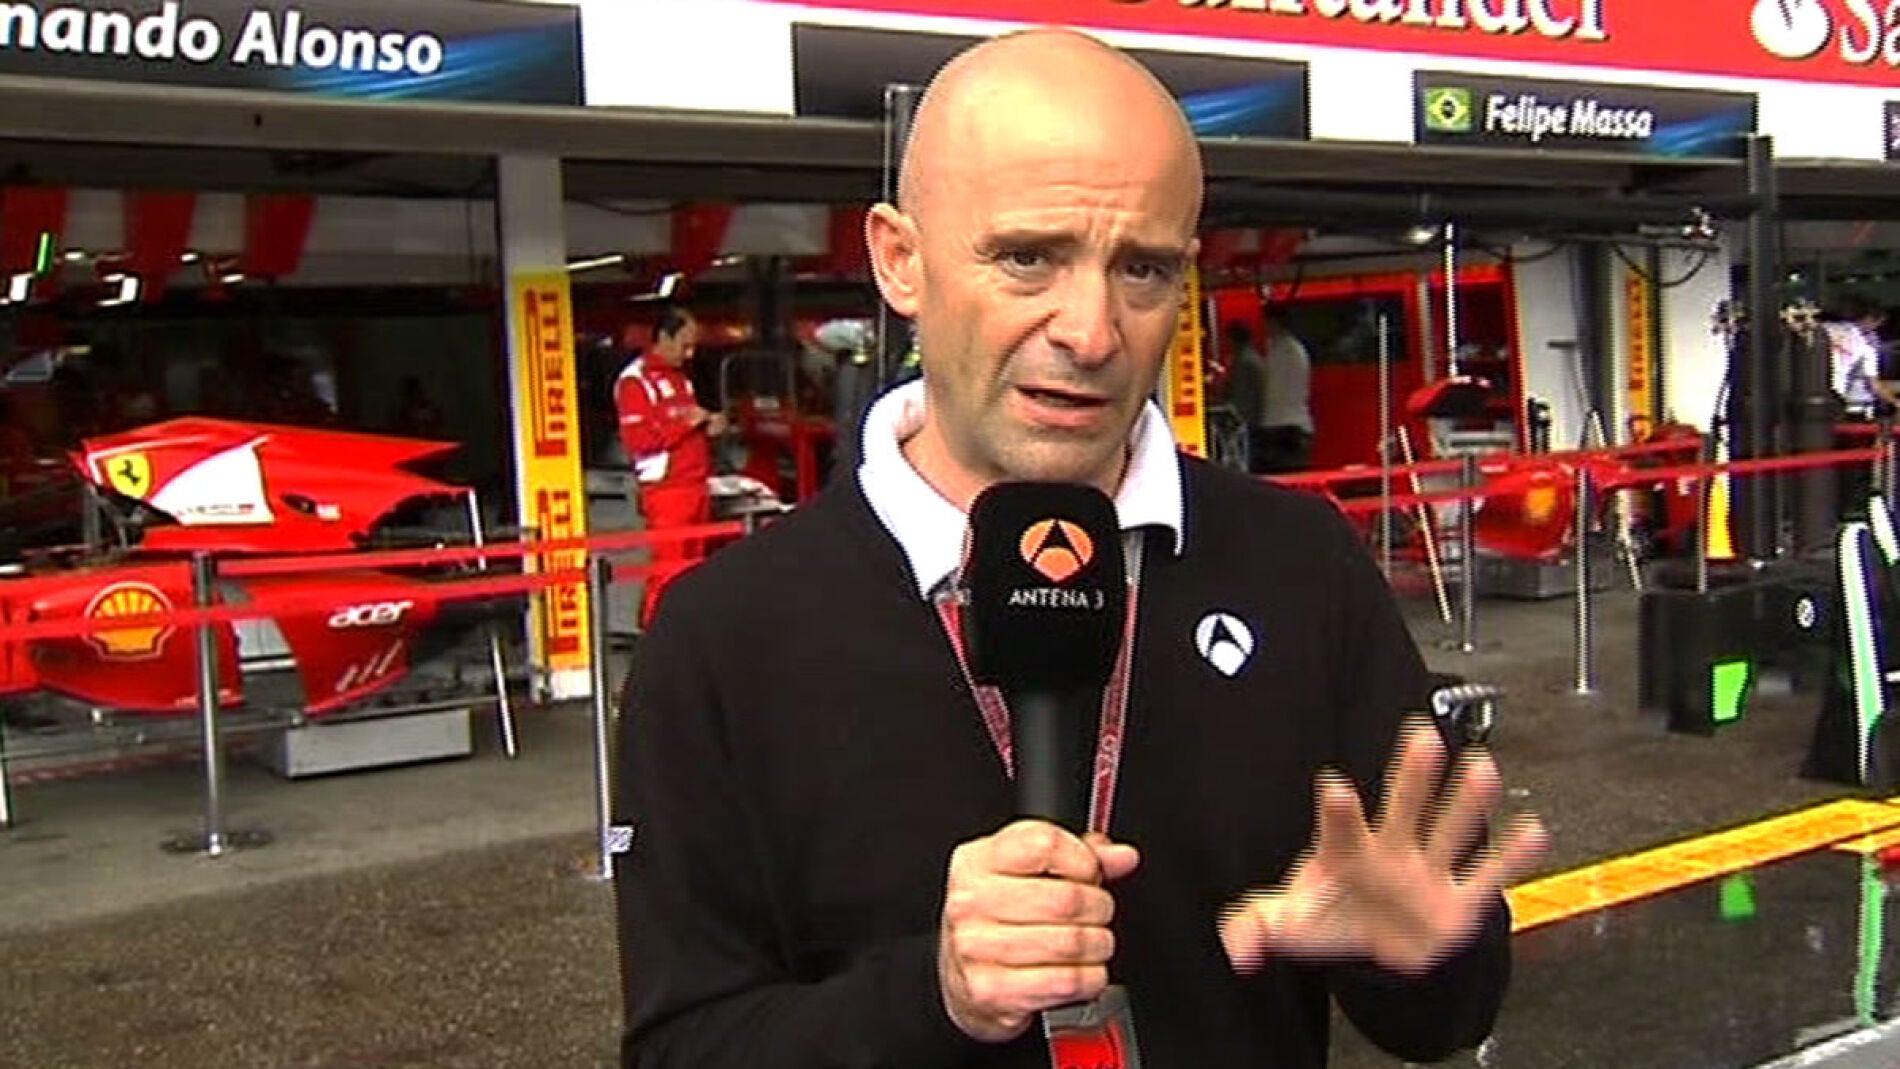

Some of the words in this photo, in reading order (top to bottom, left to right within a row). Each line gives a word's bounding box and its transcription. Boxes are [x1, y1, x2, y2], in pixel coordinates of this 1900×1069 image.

[232, 10, 442, 75] Alonso
[1485, 94, 1568, 142] Felipe
[1569, 99, 1654, 138] Massa
[524, 288, 567, 458] PIRELLI
[537, 488, 579, 655] PIRELI
[1007, 588, 1089, 607] ANTENA
[329, 600, 414, 628] acer
